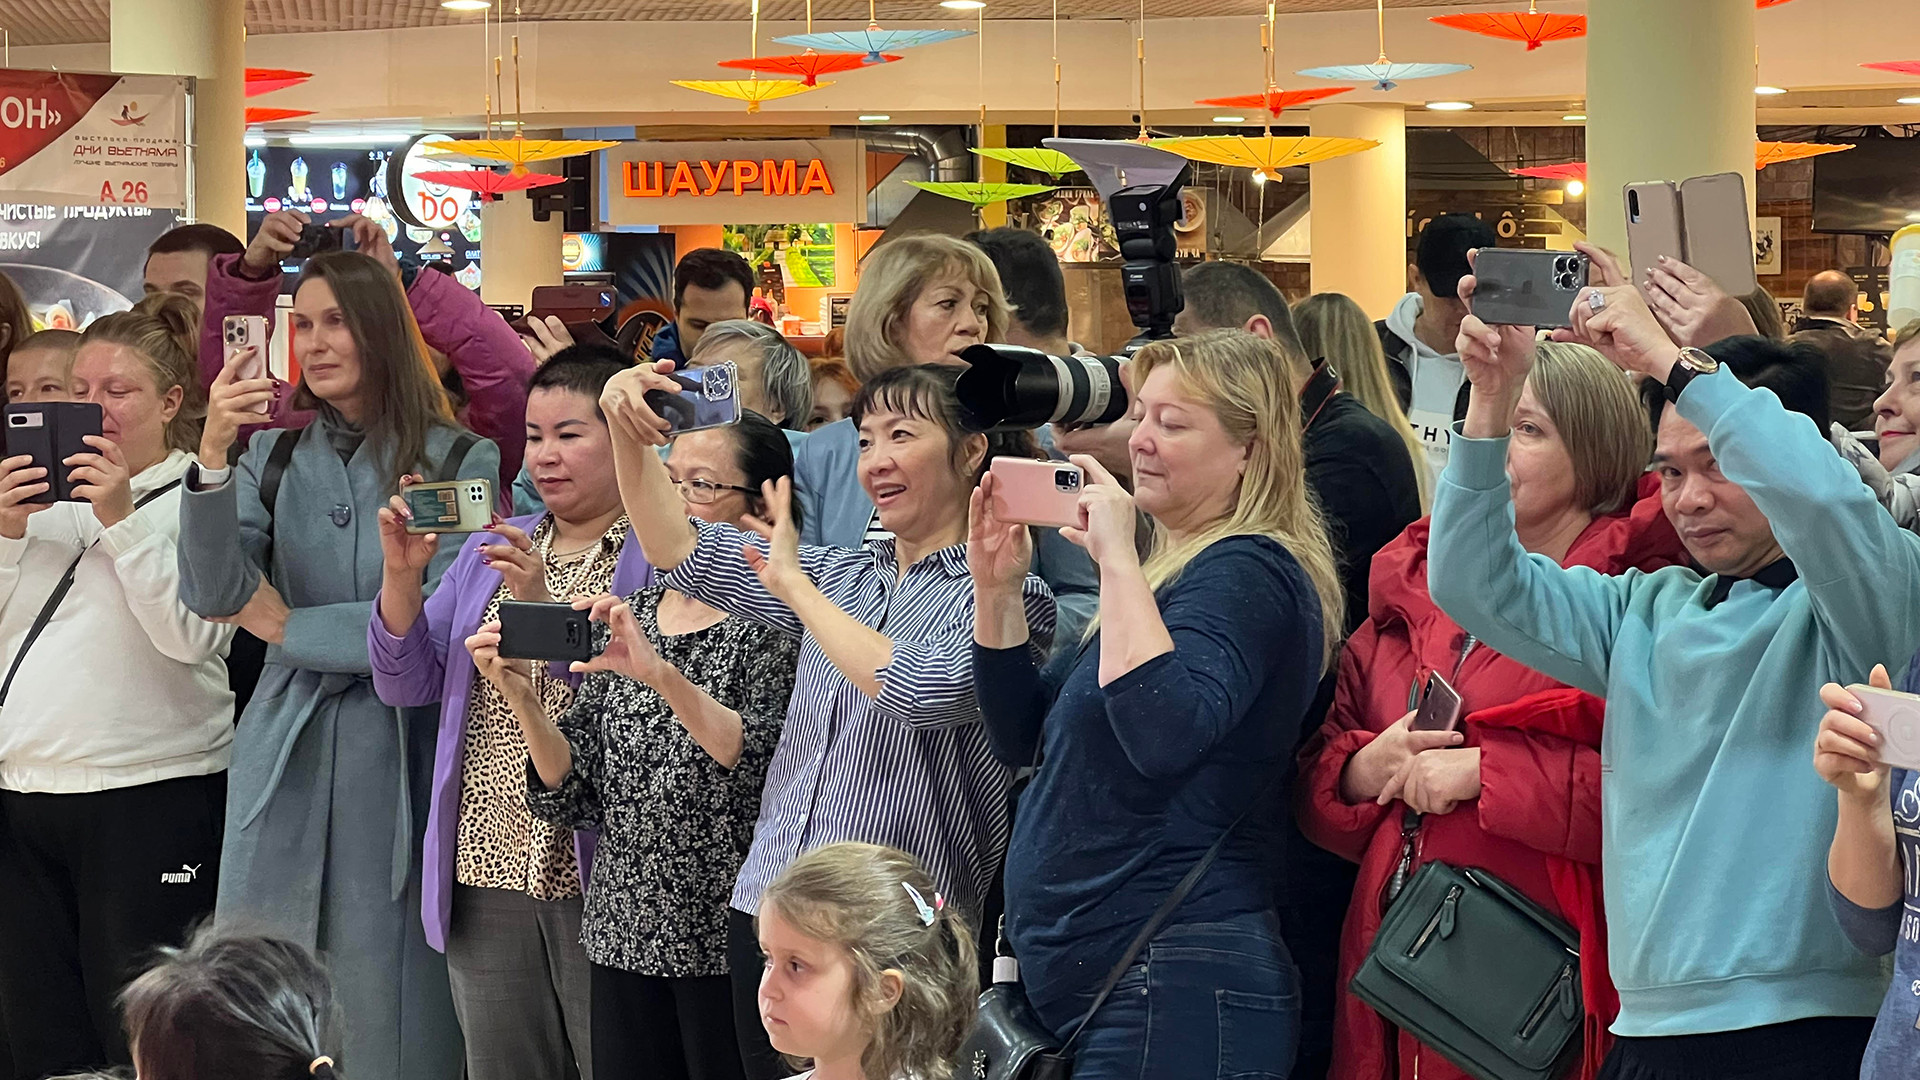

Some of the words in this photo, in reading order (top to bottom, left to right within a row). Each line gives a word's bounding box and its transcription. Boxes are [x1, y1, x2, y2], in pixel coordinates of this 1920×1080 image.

[73, 144, 102, 157] ДНИ
[107, 145, 178, 157] ВЬЕТНАМА
[622, 158, 835, 198] ШАУРМА
[122, 180, 149, 203] 26
[0, 203, 57, 220] ЧИСТЫЕ
[0, 230, 41, 250] ВКУС!
[161, 872, 191, 883] PUMA
